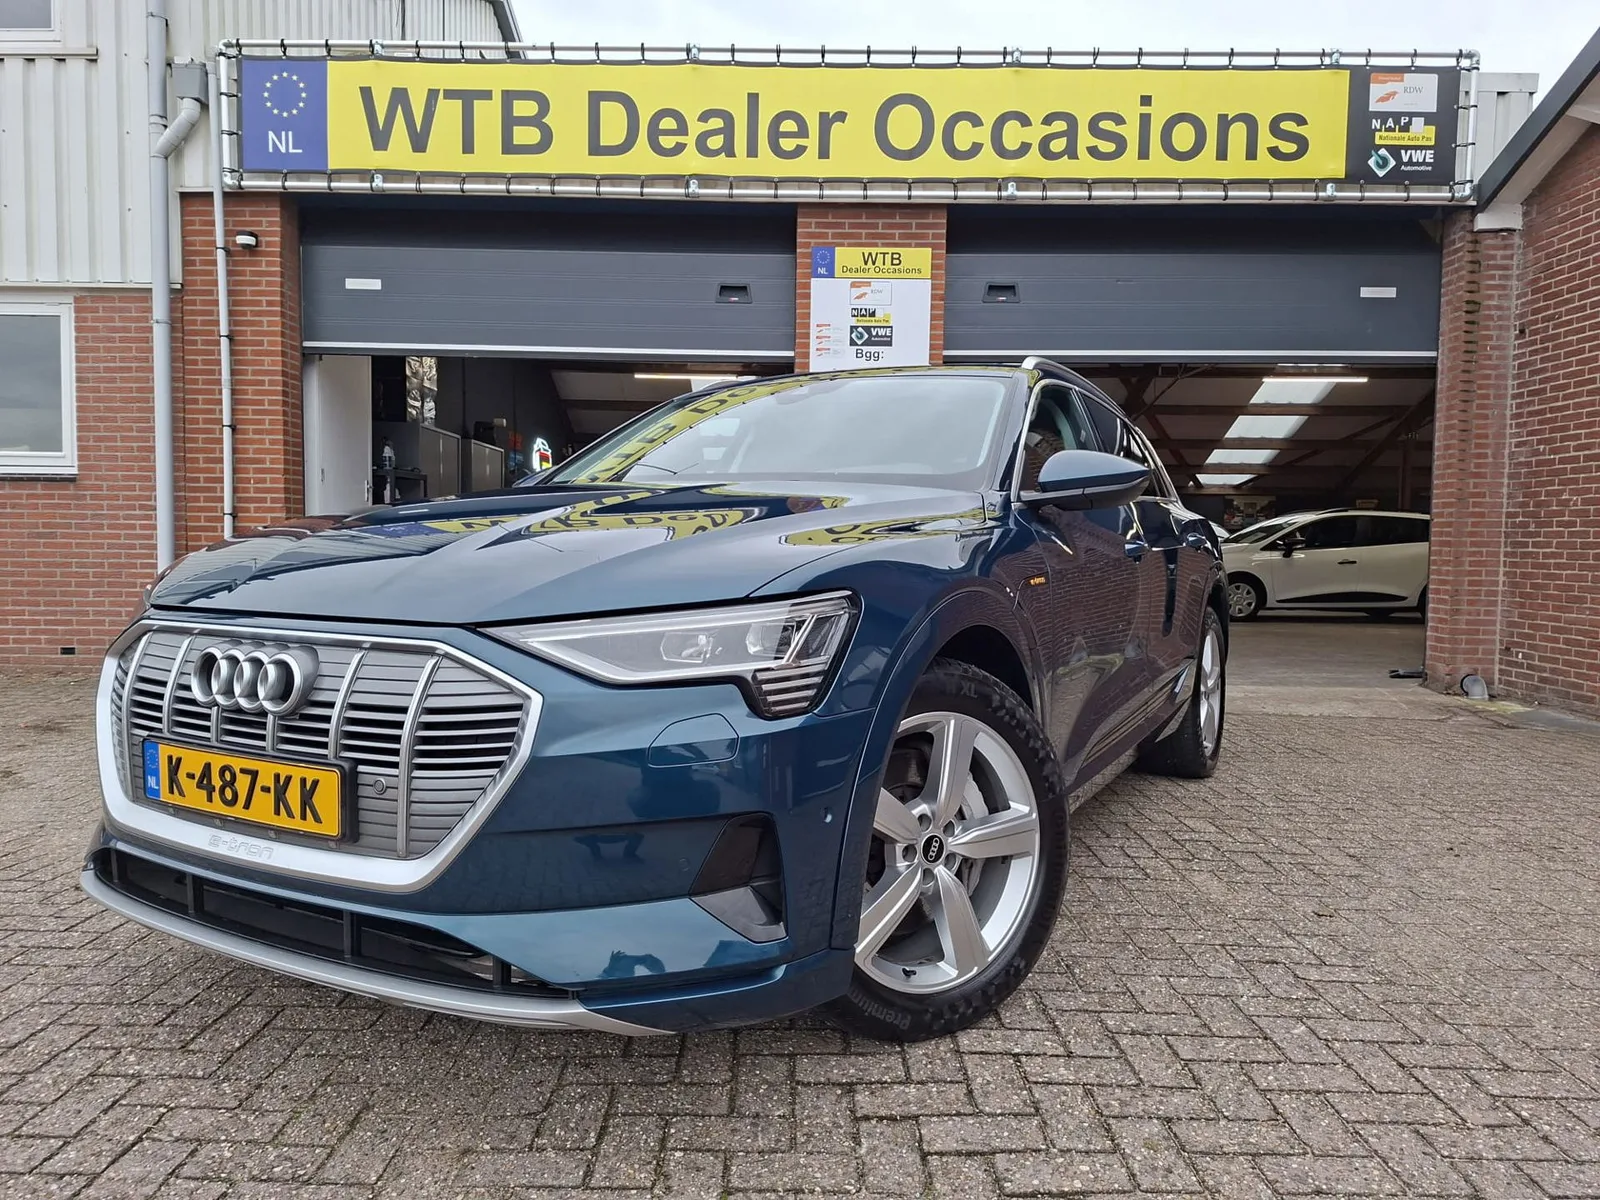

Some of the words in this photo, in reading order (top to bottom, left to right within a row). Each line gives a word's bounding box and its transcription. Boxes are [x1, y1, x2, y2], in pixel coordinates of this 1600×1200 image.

[1403, 86, 1424, 94] RDW
[358, 85, 554, 155] WTB
[587, 90, 848, 160] Dealer
[873, 93, 1311, 162] Occasions
[268, 130, 303, 154] NL
[1400, 149, 1435, 163] VWE
[861, 251, 902, 266] WTB
[817, 267, 829, 275] NL
[841, 265, 871, 274] Dealer
[873, 265, 922, 275] Occasions
[870, 327, 892, 336] VWE
[855, 348, 884, 361] Bgg:
[147, 774, 160, 791] NL
[166, 754, 323, 824] K-487-KK
[207, 834, 275, 861] e-tron
